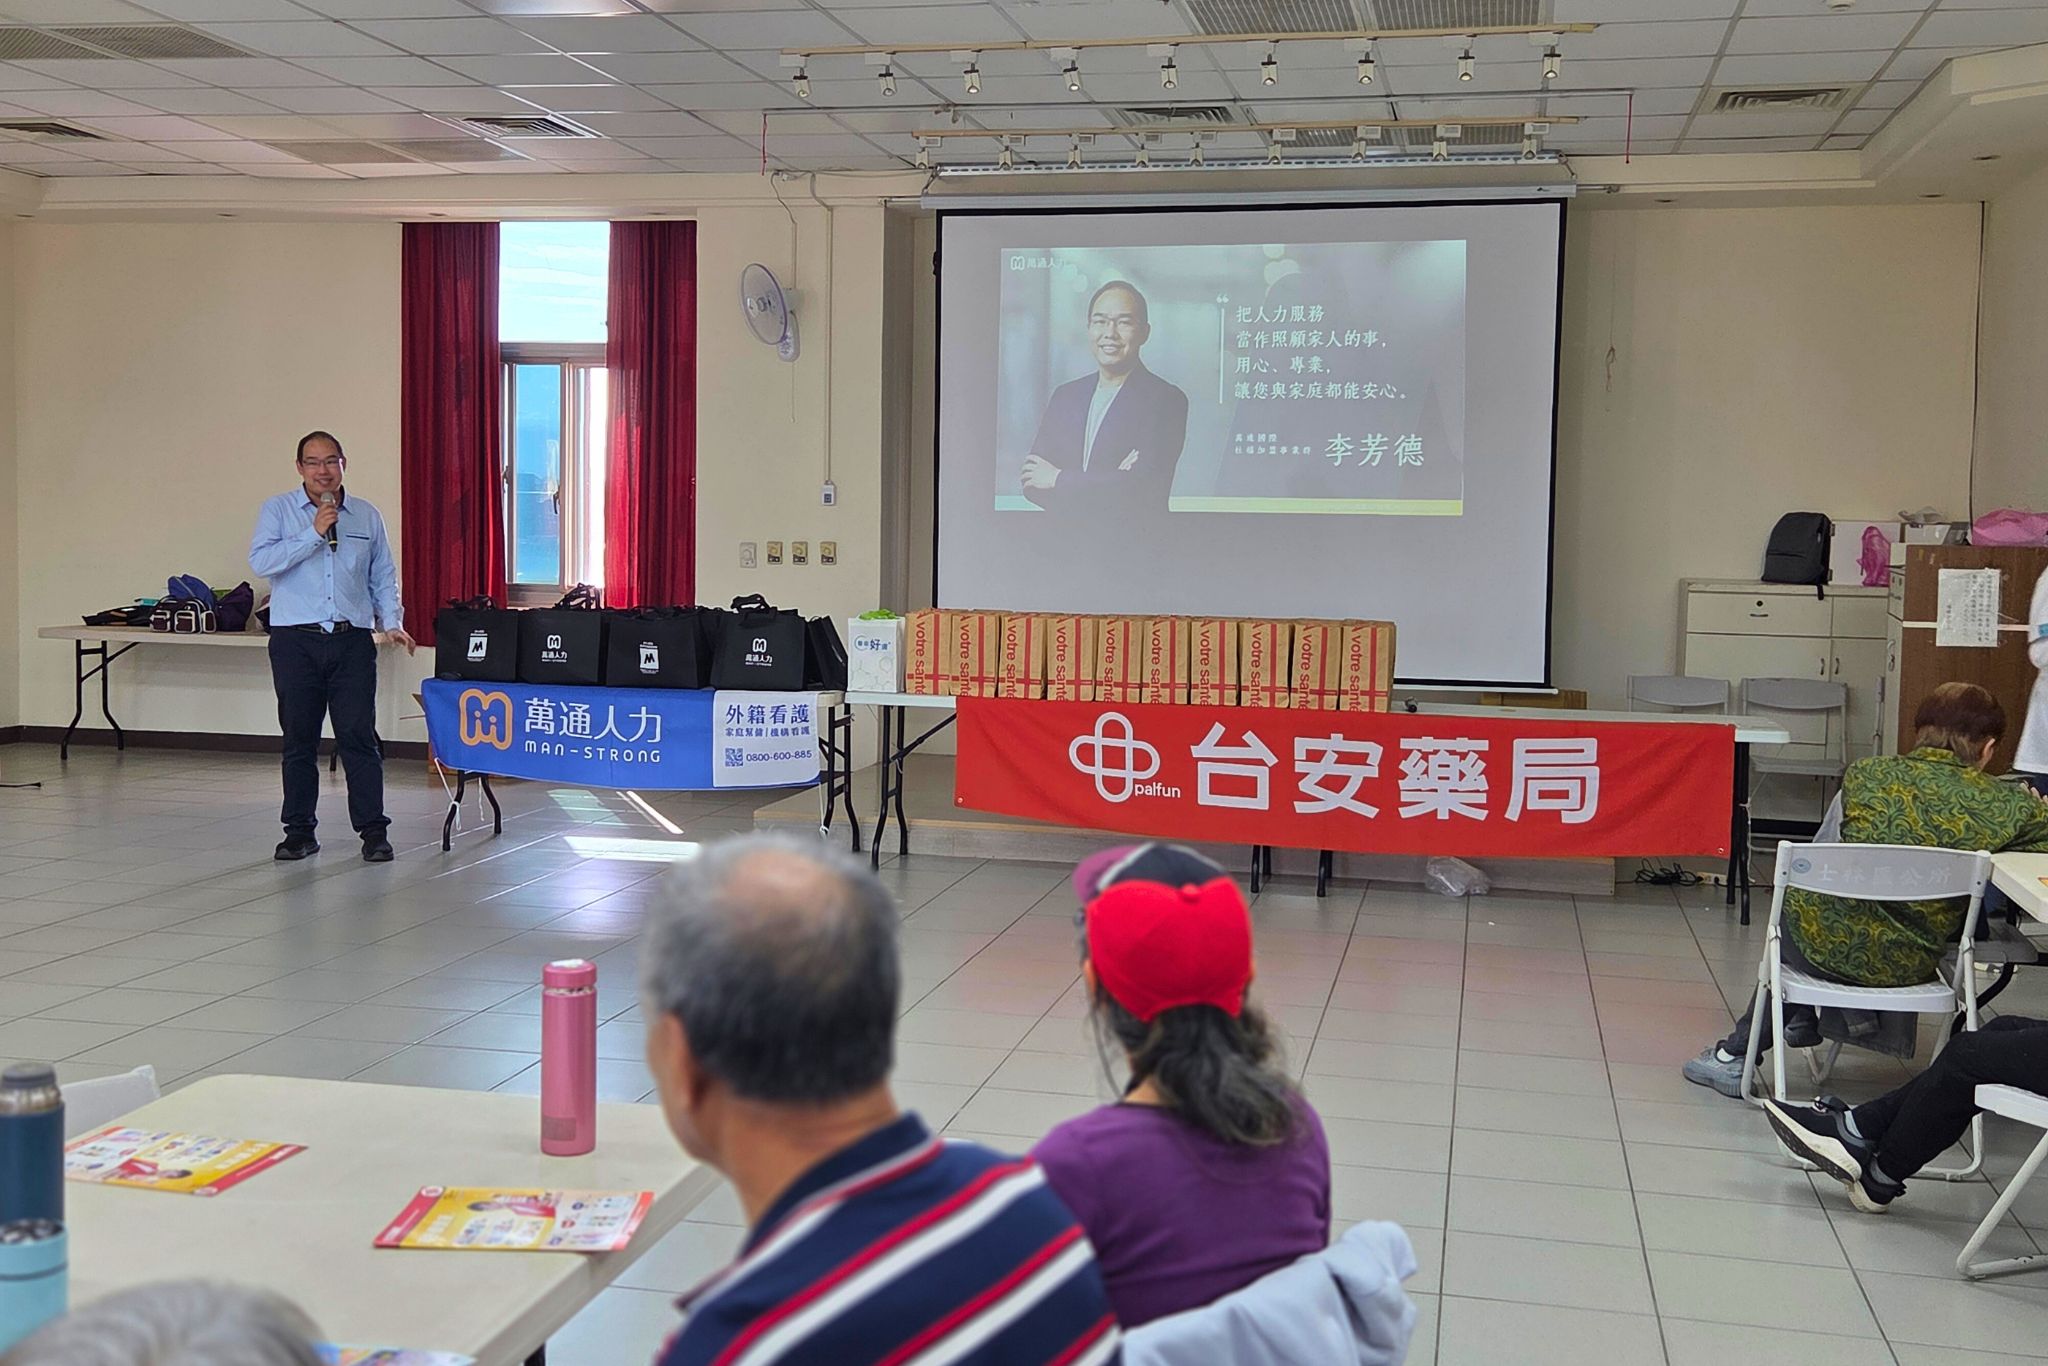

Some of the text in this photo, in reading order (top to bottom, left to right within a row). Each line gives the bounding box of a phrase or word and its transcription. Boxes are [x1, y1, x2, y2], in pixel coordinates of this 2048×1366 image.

[1236, 304, 1325, 323] 把人力服務
[1235, 381, 1406, 400] 讓您與家庭都能安心。
[1324, 433, 1425, 467] 李芳德
[916, 622, 927, 657] votre
[960, 625, 971, 659] votre
[1007, 625, 1018, 660] votre
[1057, 627, 1068, 662] votre
[1105, 629, 1116, 664] votre
[1151, 629, 1162, 665] votre
[1200, 630, 1212, 666] votre
[1252, 632, 1262, 668] votre
[1301, 635, 1313, 670] votre
[1350, 636, 1363, 672] votre
[525, 697, 661, 743] 萬通人力
[726, 704, 810, 725] 外籍看護
[525, 740, 661, 763] MAN-STRONG
[746, 750, 812, 761] 0800-600-885
[1191, 720, 1600, 824] 台安藥局
[1135, 782, 1181, 798] palfun
